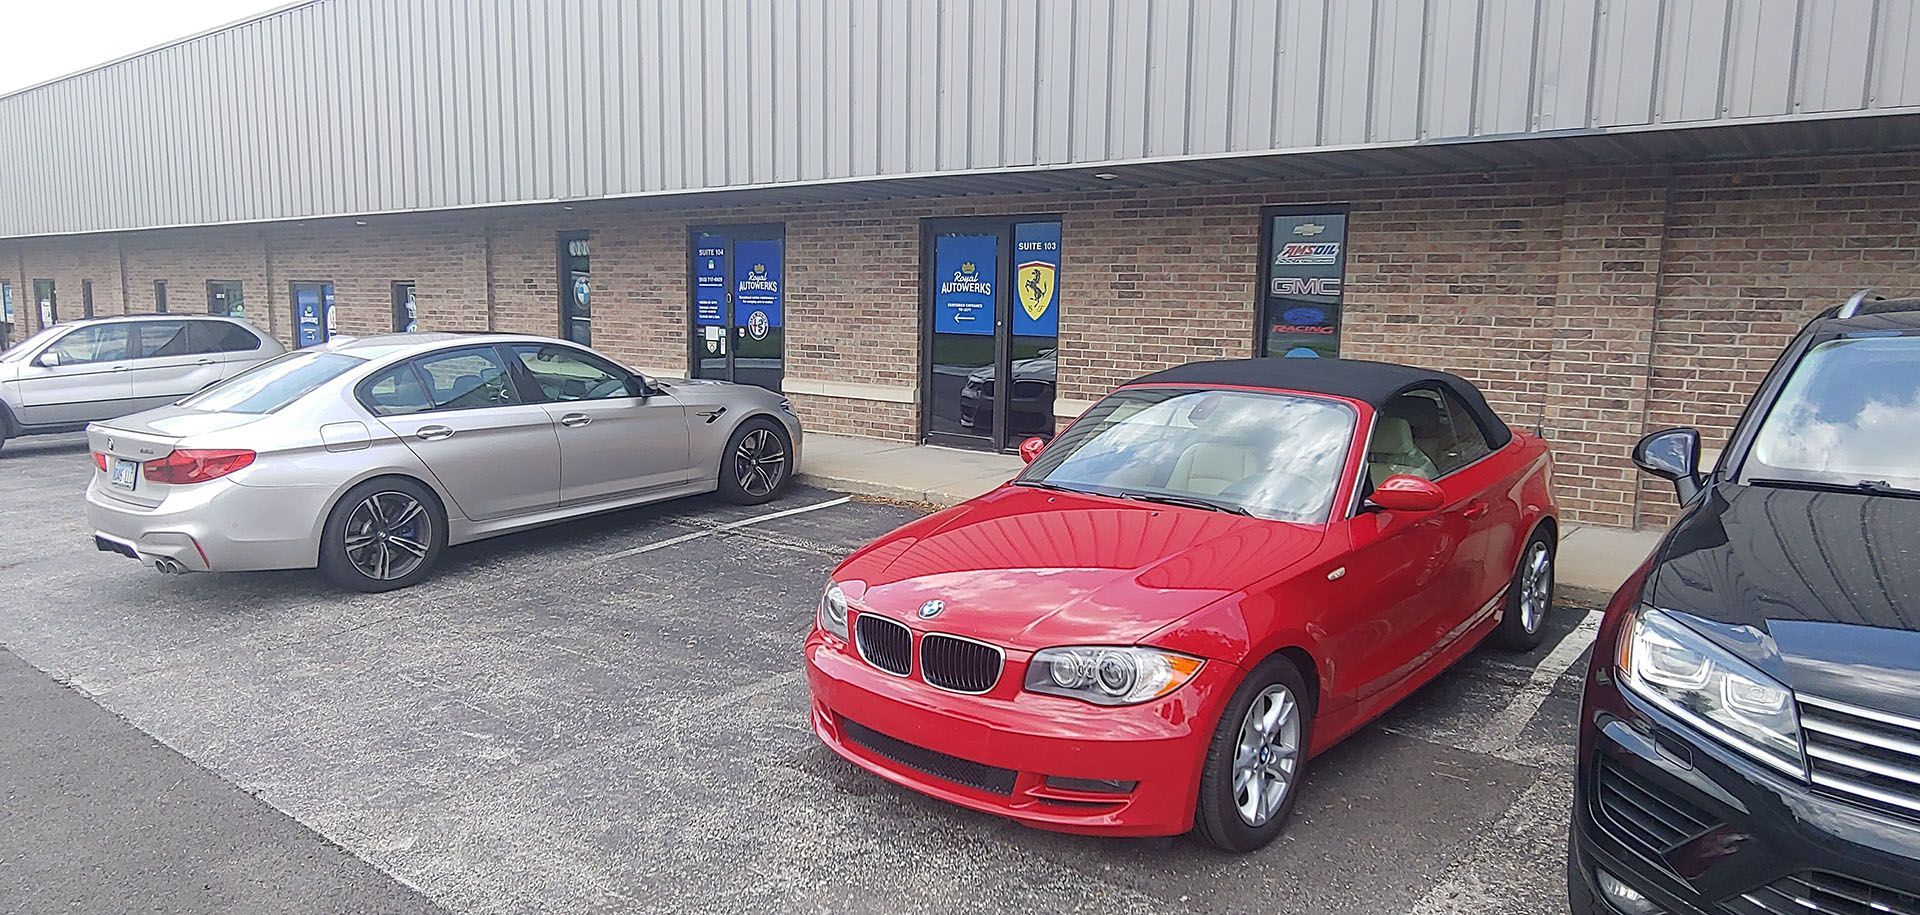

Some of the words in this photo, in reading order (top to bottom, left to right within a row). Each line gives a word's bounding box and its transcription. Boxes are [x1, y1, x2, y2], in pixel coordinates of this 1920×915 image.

[1018, 242, 1042, 250] SUITE
[1044, 242, 1057, 250] 103
[1282, 244, 1336, 257] AMSOIL
[748, 271, 768, 283] Royal
[954, 271, 979, 285] Royal
[739, 281, 778, 292] AUTOWERKS
[941, 282, 991, 295] AUTOWERKS
[1271, 277, 1340, 295] GMC
[1272, 324, 1335, 334] RACING
